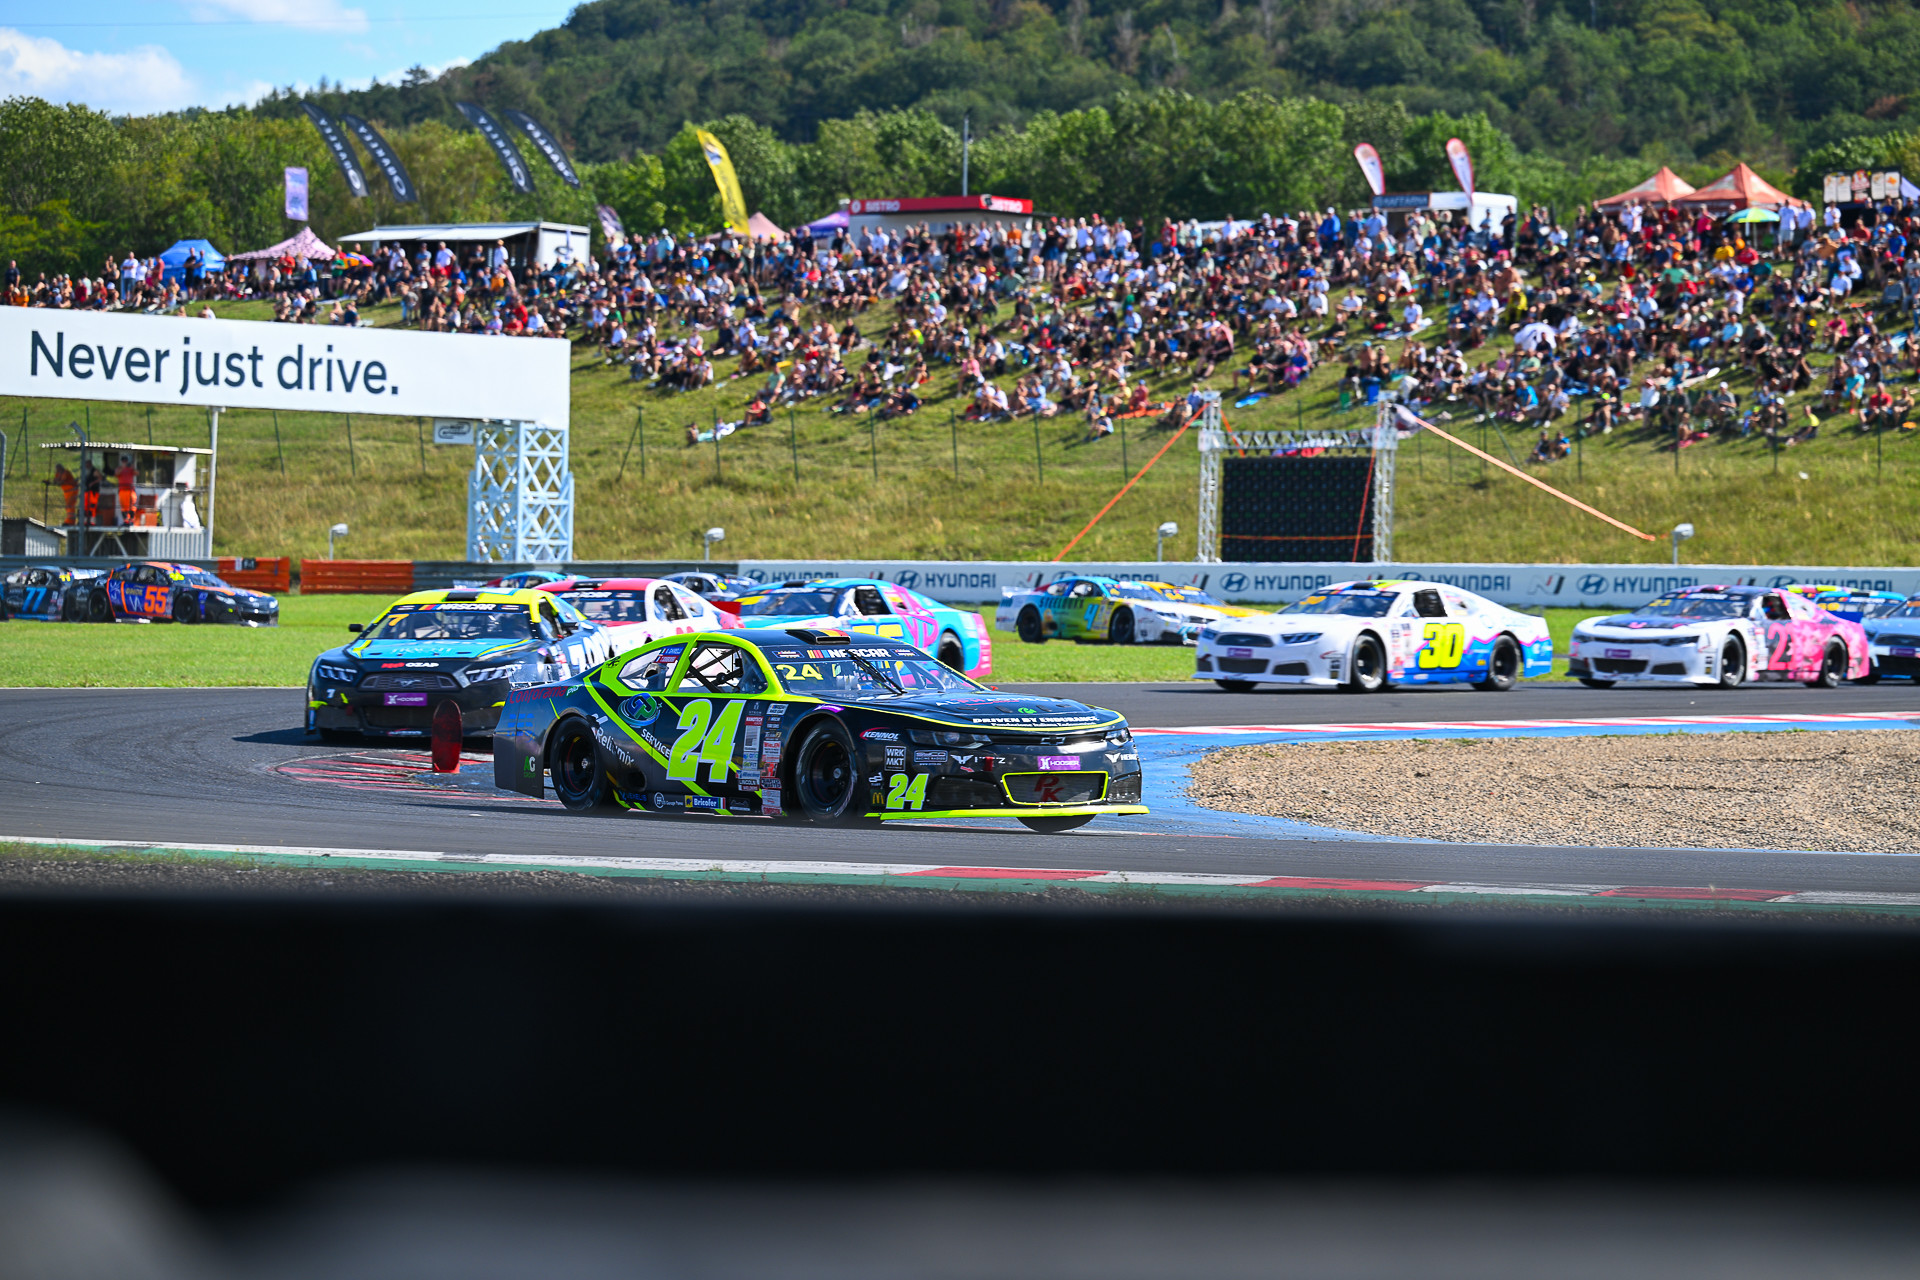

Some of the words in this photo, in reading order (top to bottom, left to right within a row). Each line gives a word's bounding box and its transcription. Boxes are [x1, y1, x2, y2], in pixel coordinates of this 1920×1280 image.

[865, 200, 901, 212] BISTRO
[31, 330, 170, 383] Never
[180, 336, 263, 396] just
[276, 344, 399, 395] drive.
[925, 573, 996, 588] HYUNDAI
[1614, 575, 1699, 592] HYUNDAI
[22, 586, 47, 613] 77
[143, 585, 170, 614] 55
[437, 603, 497, 611] NASCAR
[387, 613, 410, 627] 7
[1083, 603, 1100, 631] 4
[1418, 622, 1465, 669] 30
[775, 663, 824, 681] 24
[326, 689, 336, 699] 7
[509, 686, 568, 704] Conforama
[641, 728, 671, 758] SERVICE
[665, 698, 746, 784] 24
[862, 731, 900, 739] KENNOL
[886, 748, 905, 757] WRK
[886, 758, 904, 766] MKT
[886, 773, 930, 810] 24
[693, 798, 718, 807] Bricofer
